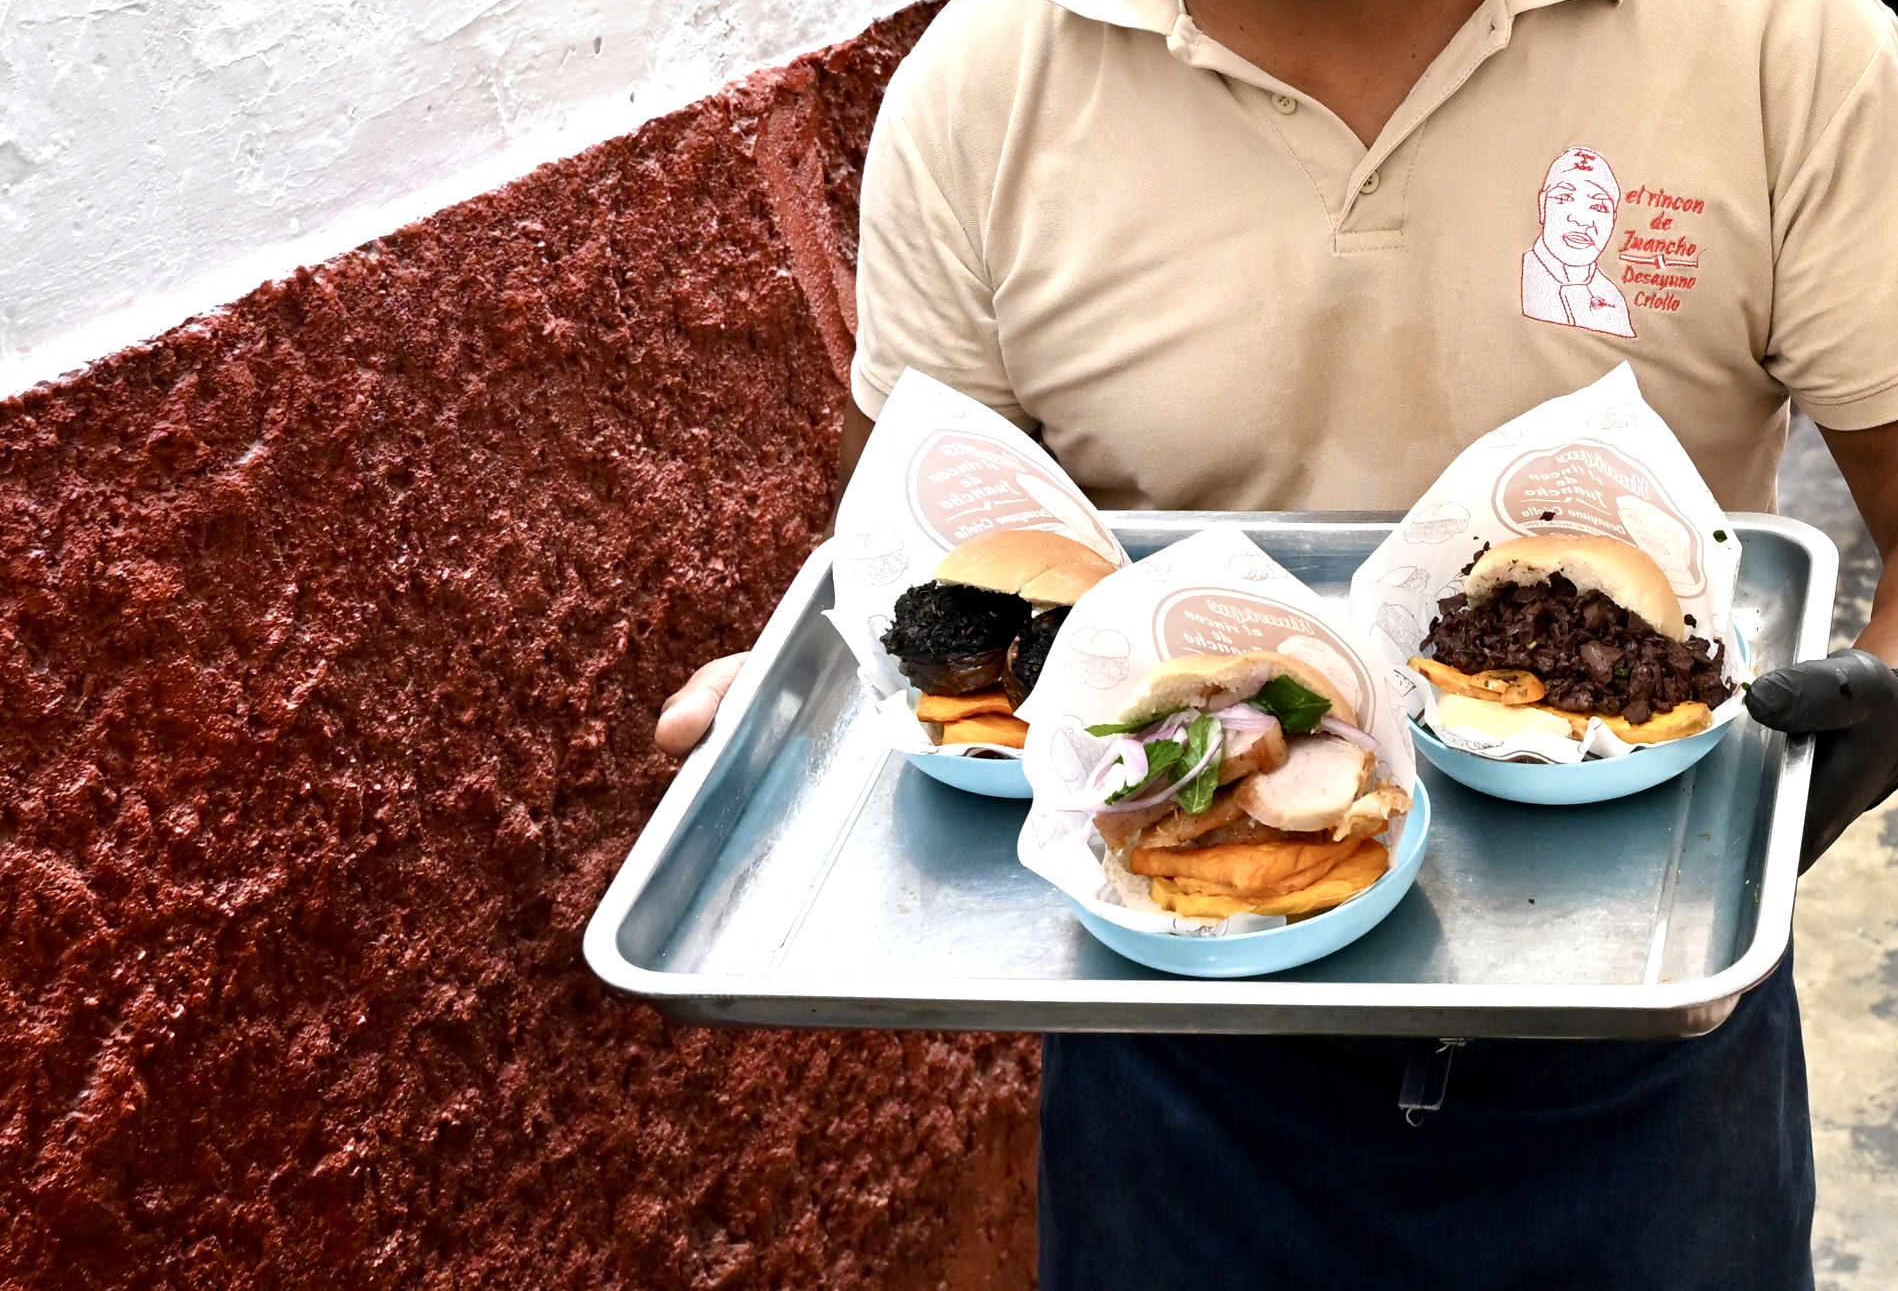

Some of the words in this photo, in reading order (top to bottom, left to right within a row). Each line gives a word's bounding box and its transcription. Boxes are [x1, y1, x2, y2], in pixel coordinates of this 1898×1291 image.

[1624, 184, 1646, 204] el
[1646, 188, 1705, 214] rincon
[1650, 211, 1673, 231] de
[1618, 230, 1698, 257] Juancho
[1621, 265, 1697, 290] Desayuno
[1633, 291, 1681, 312] Criollo
